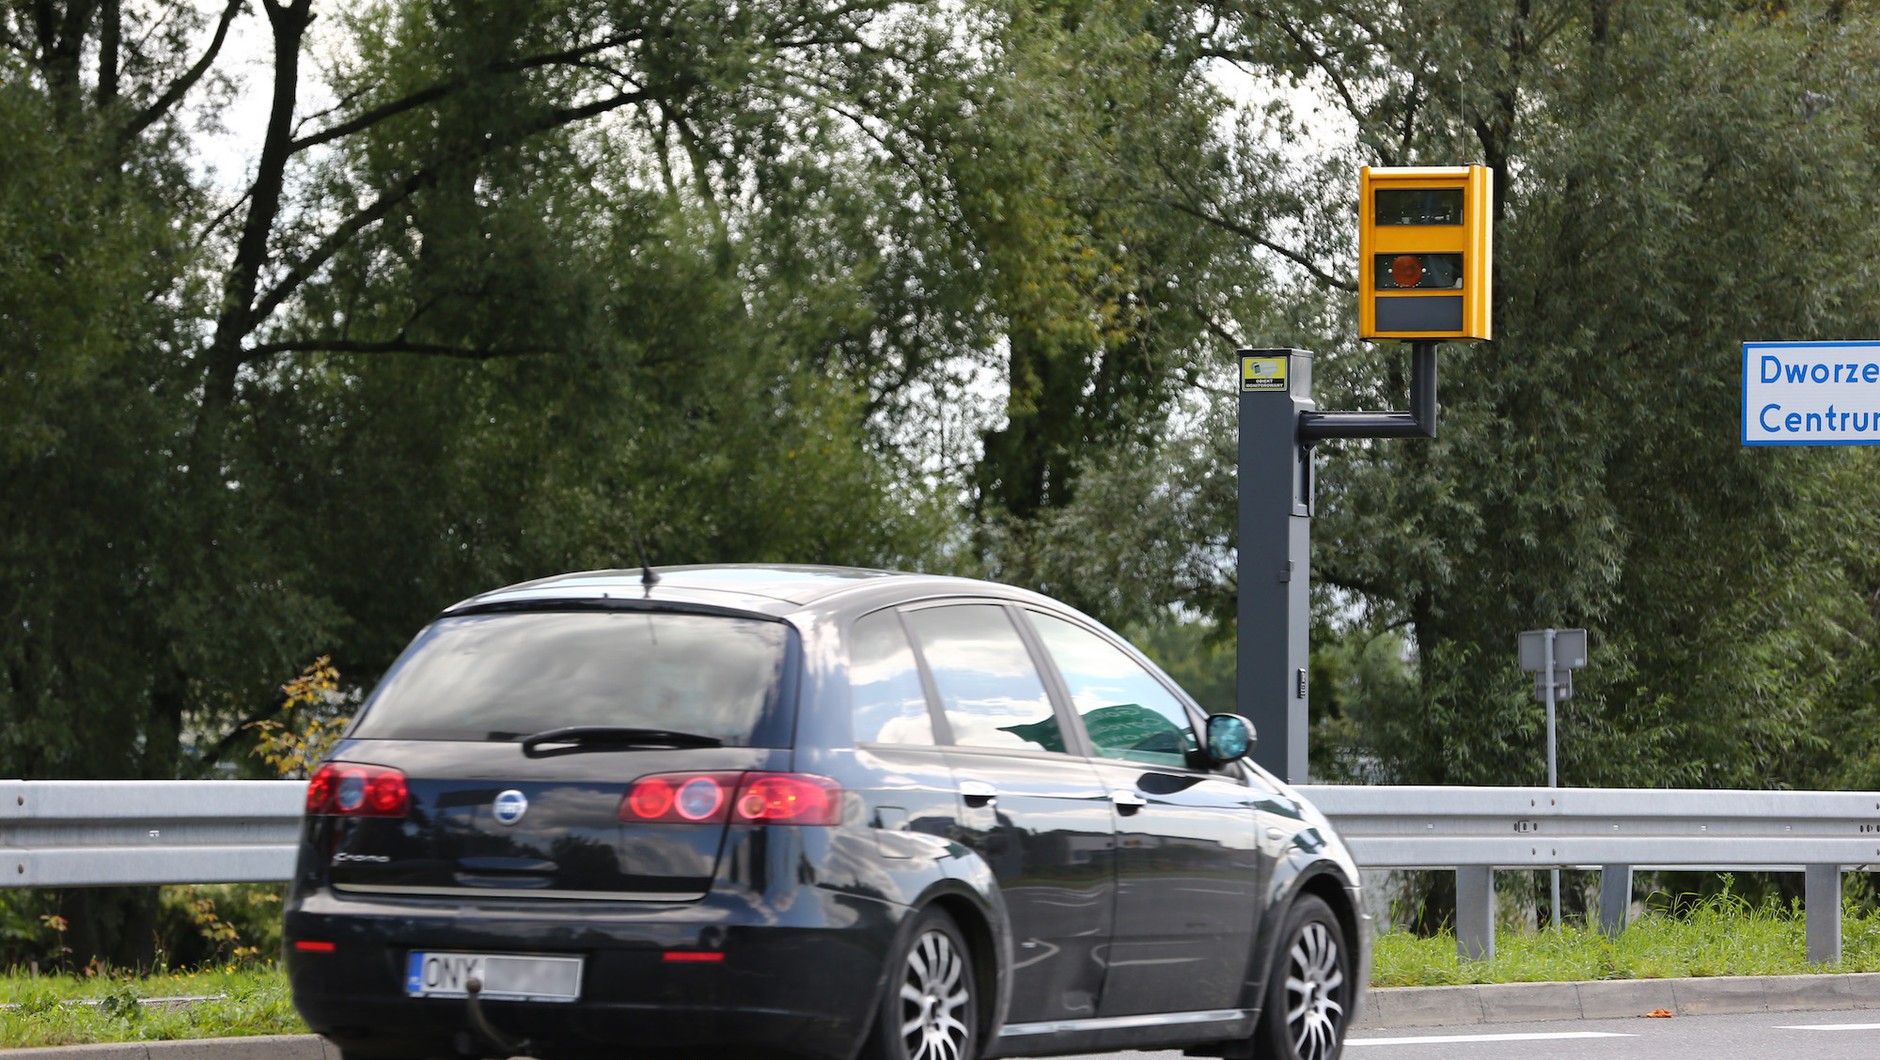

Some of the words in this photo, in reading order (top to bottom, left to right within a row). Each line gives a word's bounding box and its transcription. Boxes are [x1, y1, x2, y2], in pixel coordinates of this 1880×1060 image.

[1761, 355, 1880, 383] Dworze
[1760, 403, 1880, 432] Centru
[426, 957, 478, 988] ONY
